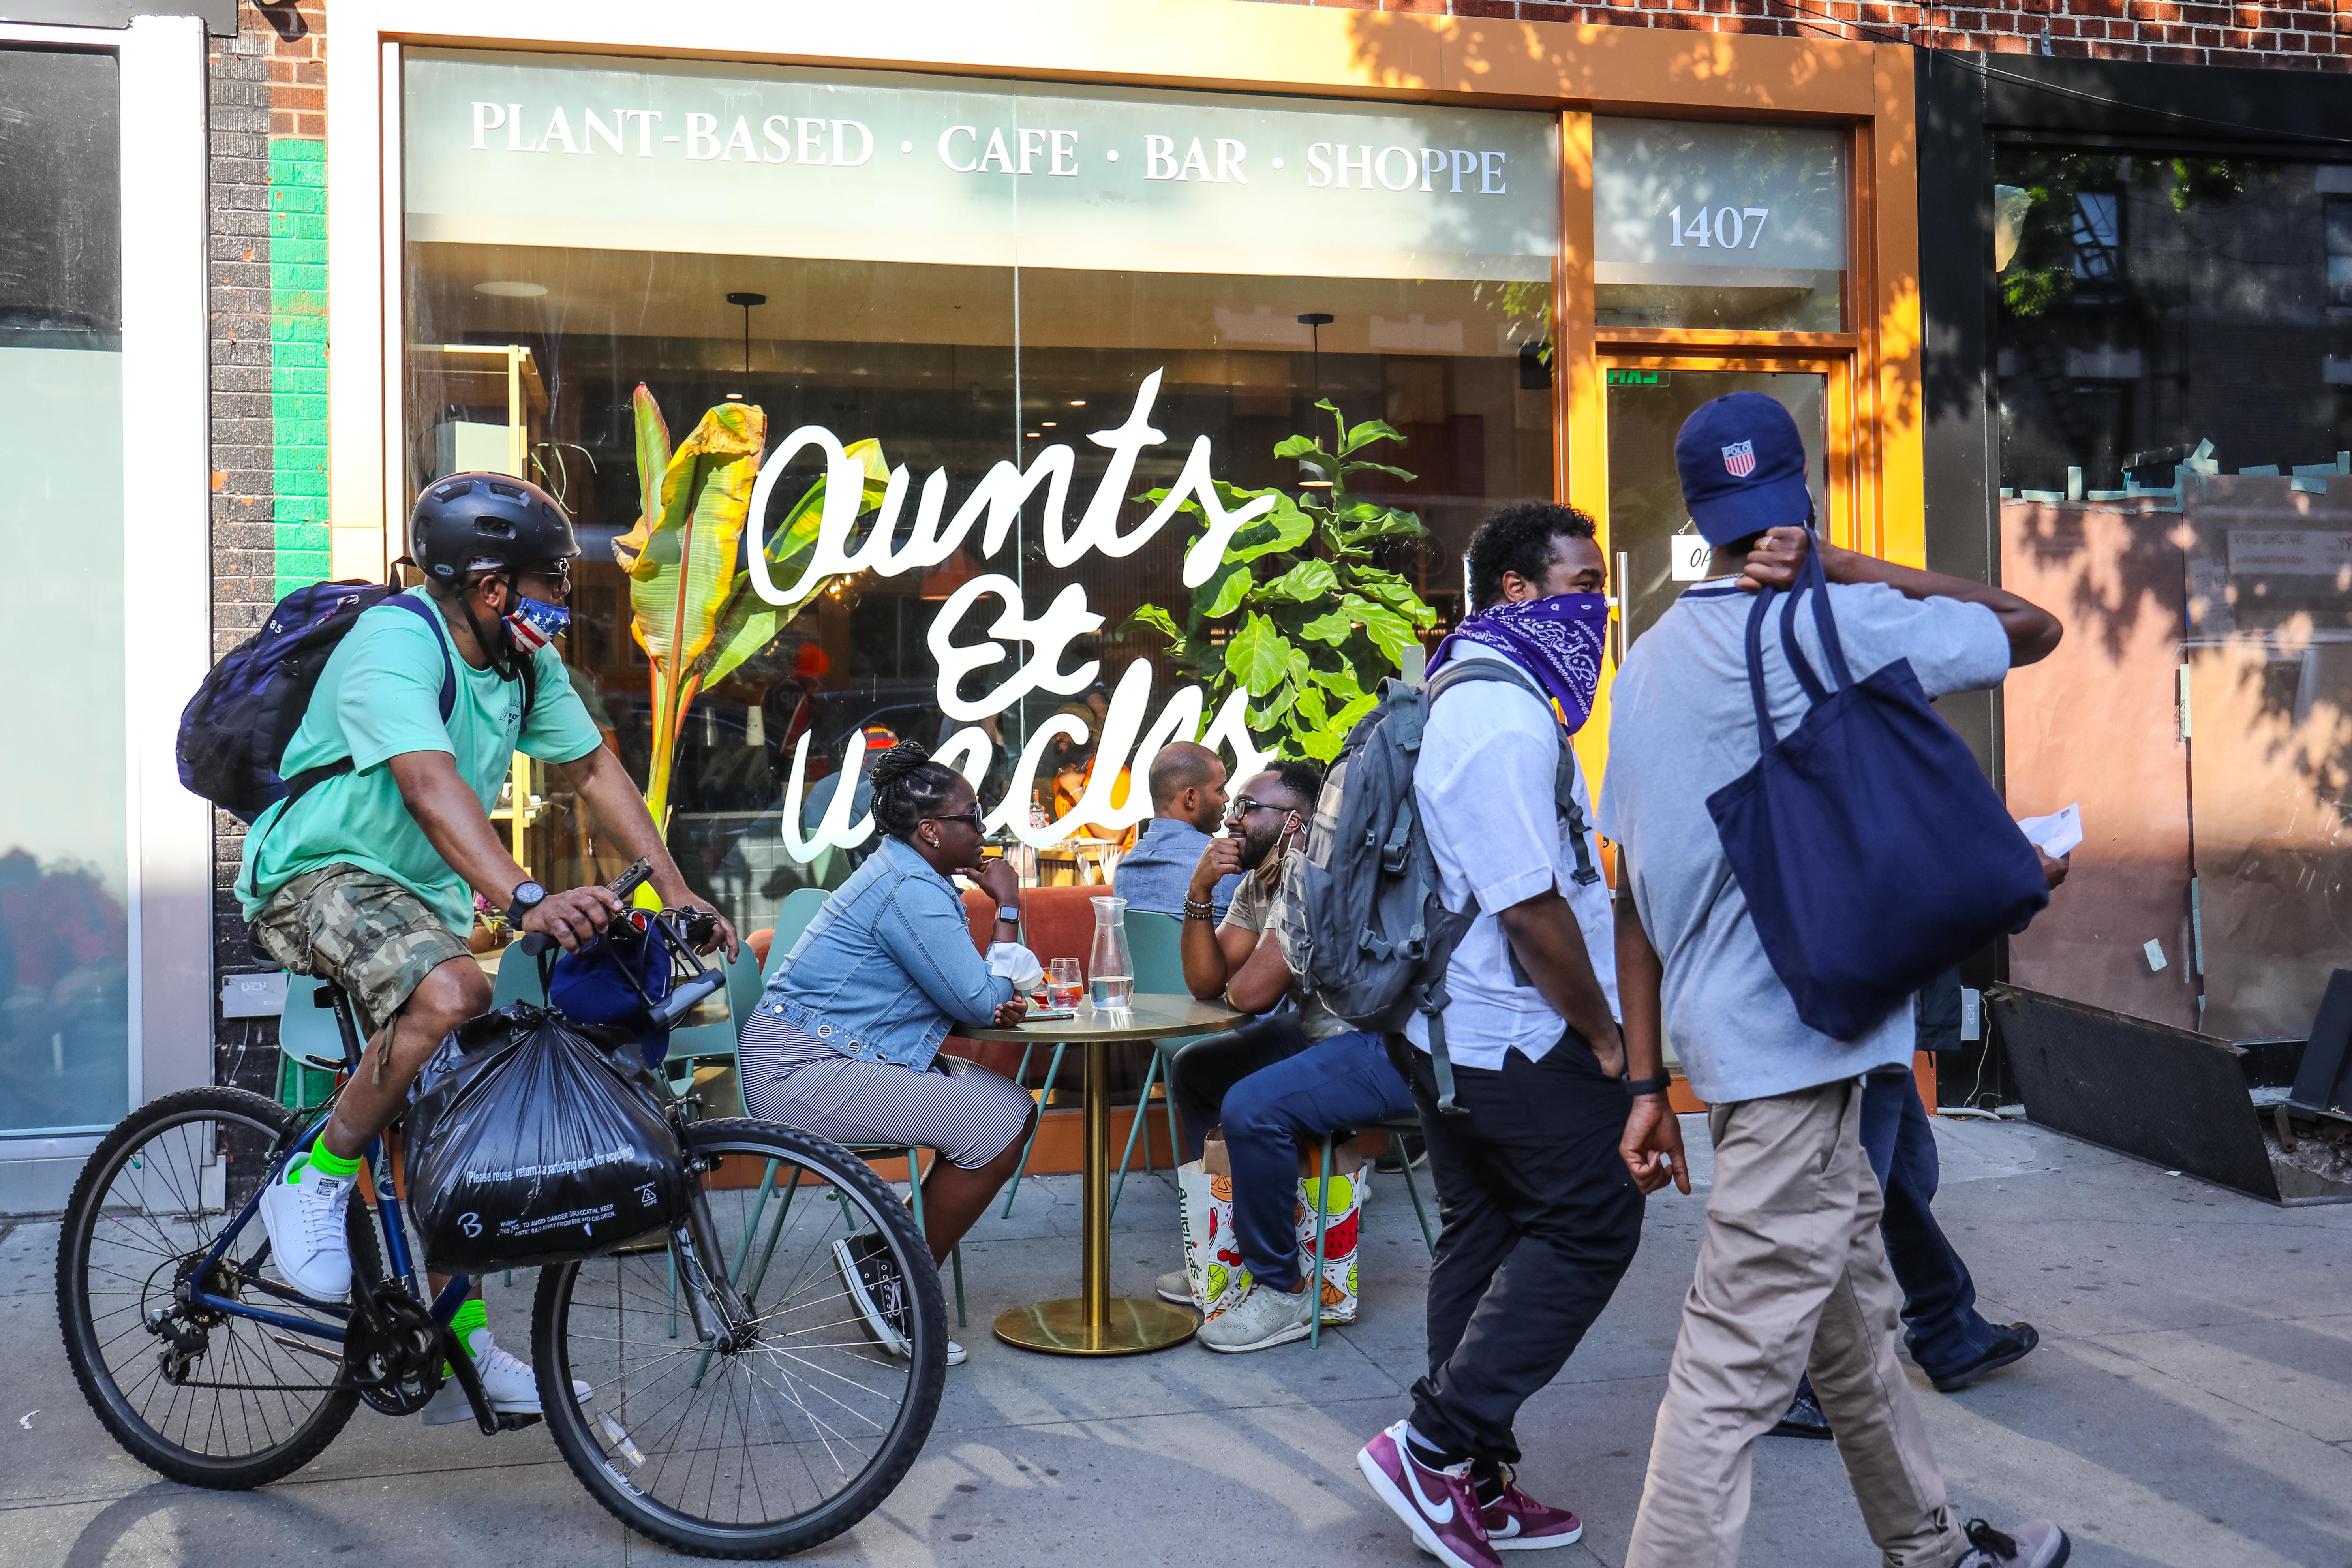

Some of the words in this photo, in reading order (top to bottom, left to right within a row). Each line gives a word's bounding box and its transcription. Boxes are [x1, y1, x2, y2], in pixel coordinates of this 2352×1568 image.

[471, 101, 874, 167] PLANT-BASED
[937, 125, 1079, 177] CAFE
[1143, 134, 1248, 185] BAR
[1306, 142, 1506, 195] SHOPPE
[1668, 205, 1769, 249] 1407
[1724, 444, 1749, 457] POLO
[270, 619, 283, 633] 85
[333, 995, 344, 1019] IANT
[516, 1165, 537, 1178] return
[595, 1153, 605, 1166] for
[605, 1144, 635, 1164] ecycling)
[643, 1198, 658, 1207] HDPE
[531, 1218, 546, 1227] AVOID
[547, 1212, 569, 1222] DANGER
[600, 1204, 614, 1213] KEEP
[542, 1222, 556, 1230] AWAY
[557, 1219, 571, 1228] FROM
[607, 1461, 623, 1478] MATRIX
